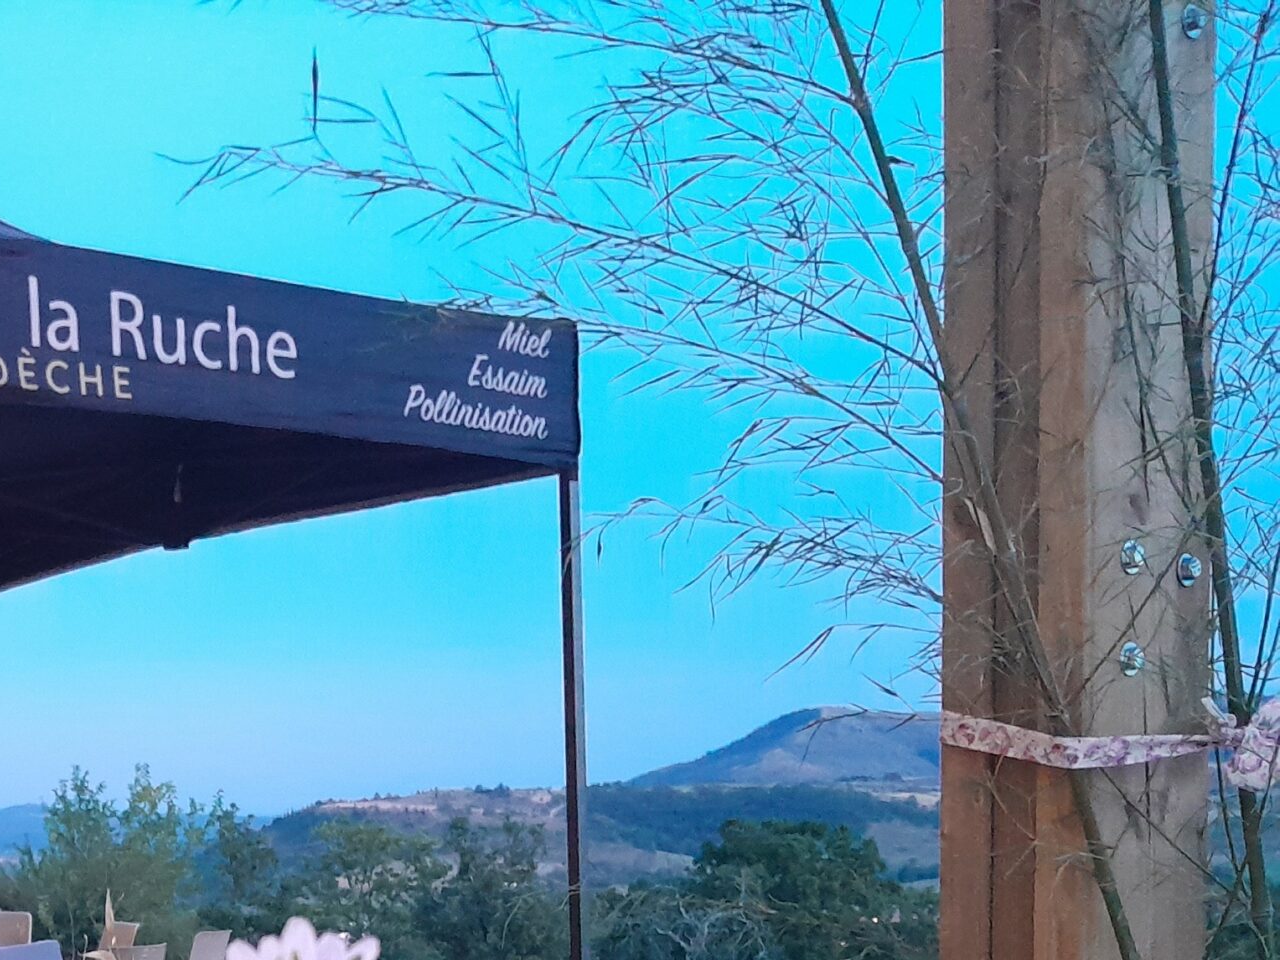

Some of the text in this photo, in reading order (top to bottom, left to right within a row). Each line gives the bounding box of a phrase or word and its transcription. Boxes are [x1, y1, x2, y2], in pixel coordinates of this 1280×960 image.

[27, 274, 81, 352] la
[109, 289, 299, 379] Ruche
[497, 320, 553, 359] Miel
[467, 354, 548, 399] Essaim
[403, 384, 549, 440] Pollinisation
